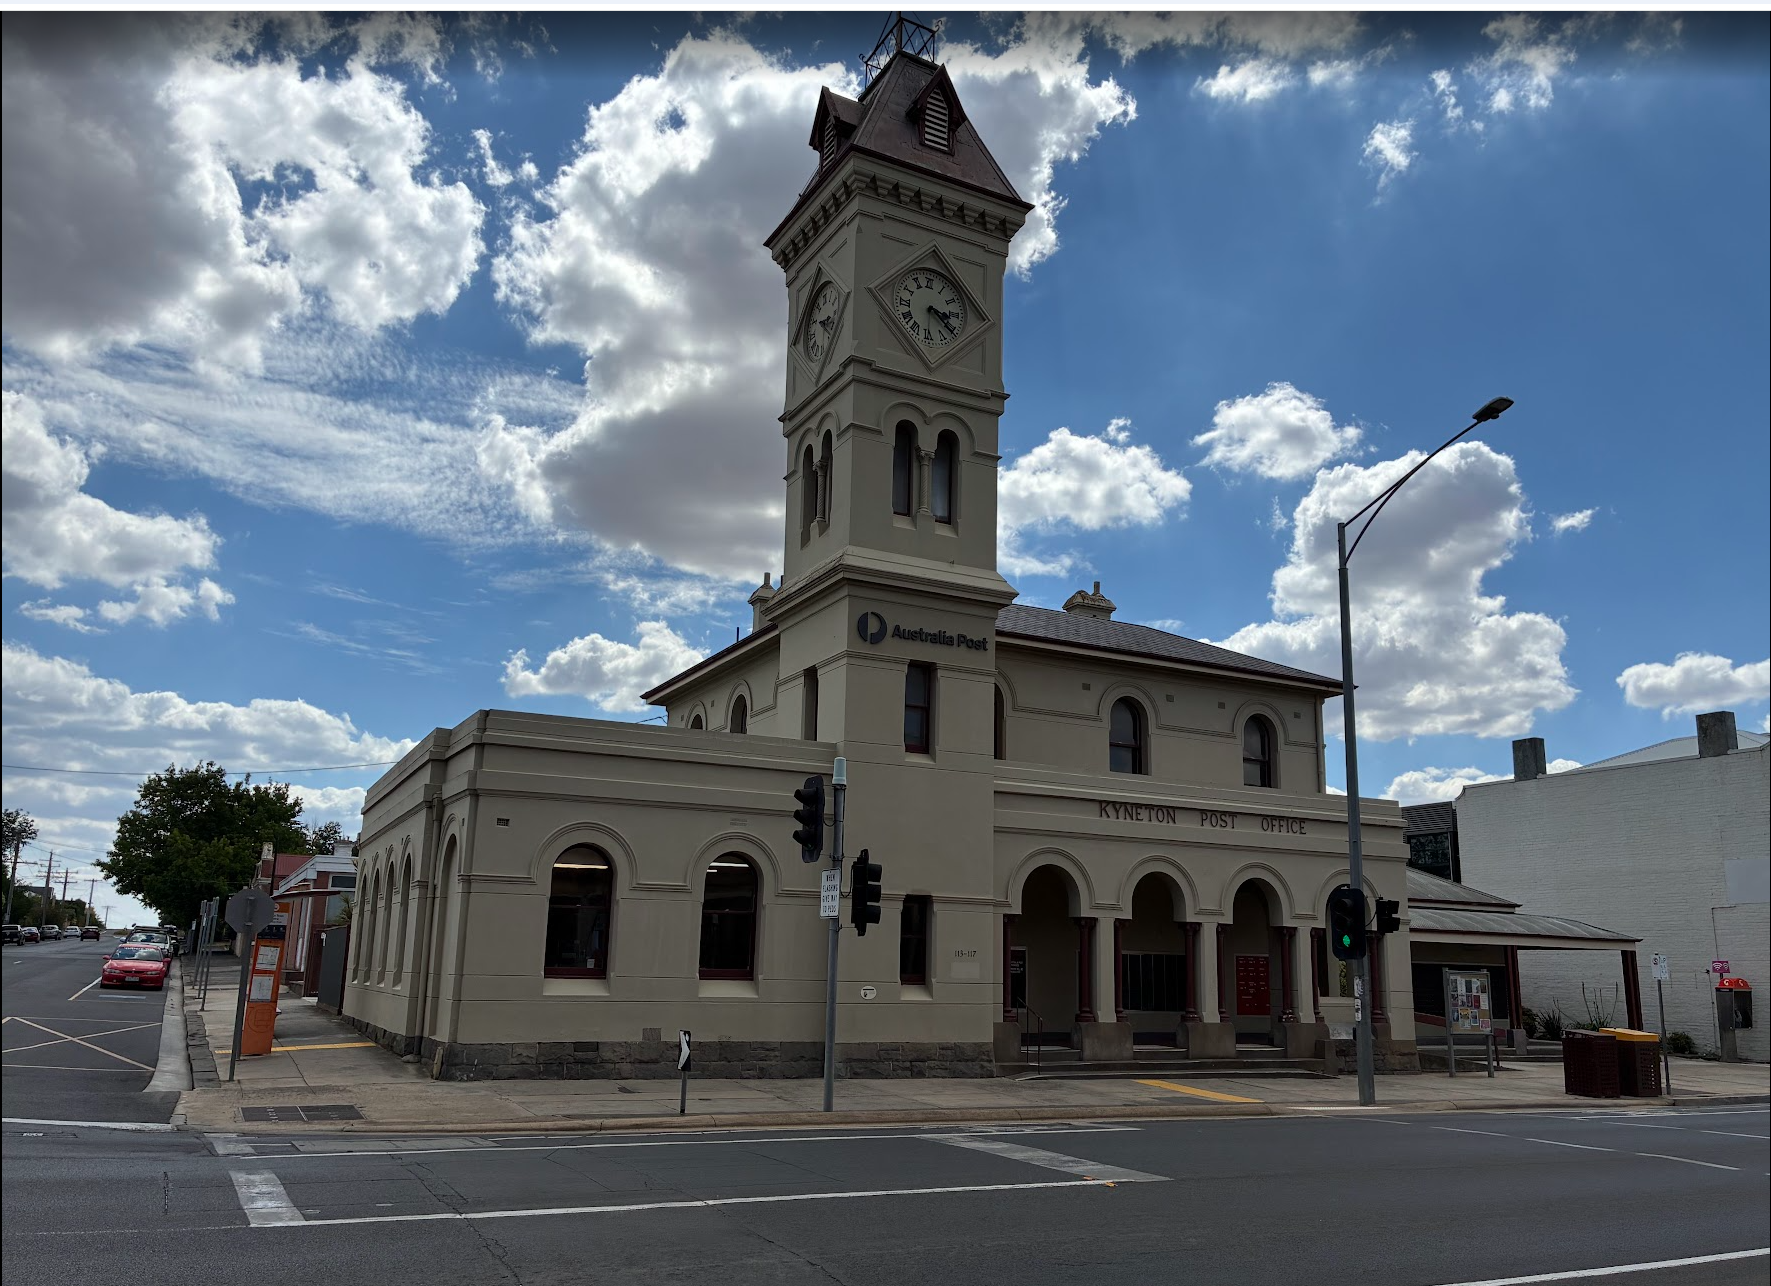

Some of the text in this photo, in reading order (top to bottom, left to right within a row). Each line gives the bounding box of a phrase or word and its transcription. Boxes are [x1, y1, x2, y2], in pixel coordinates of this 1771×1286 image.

[892, 624, 989, 652] Australia Post
[1099, 801, 1307, 835] KYNETON POST OFFICE
